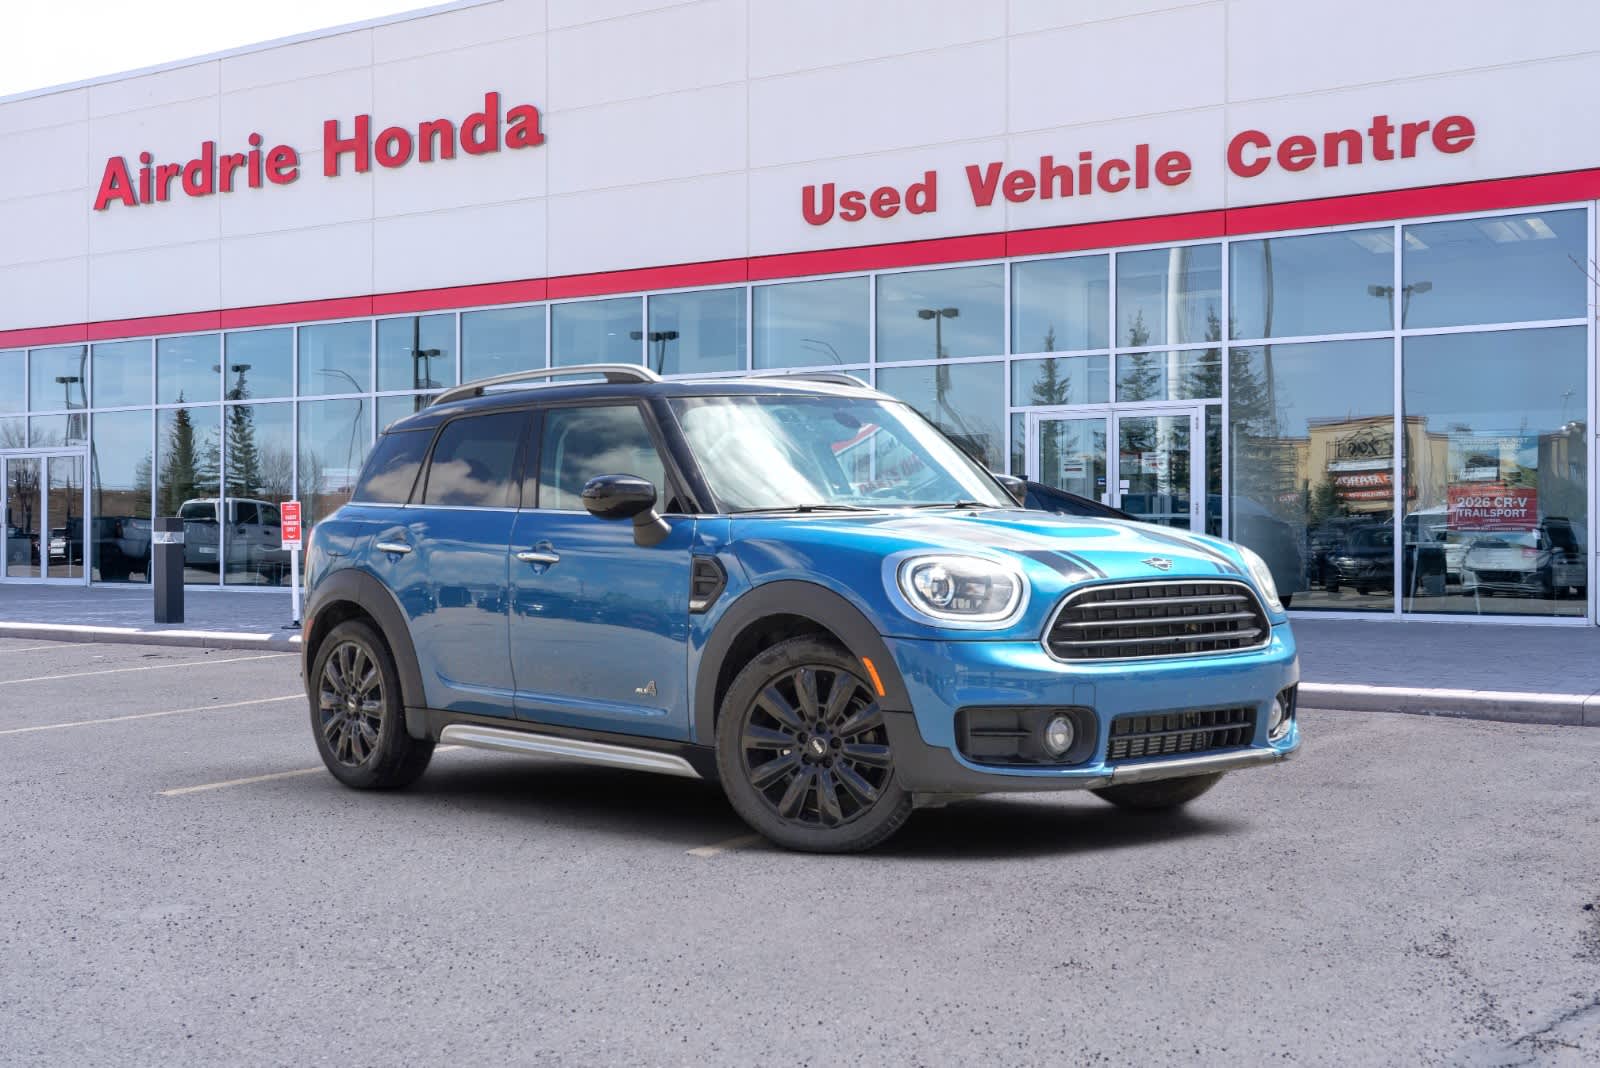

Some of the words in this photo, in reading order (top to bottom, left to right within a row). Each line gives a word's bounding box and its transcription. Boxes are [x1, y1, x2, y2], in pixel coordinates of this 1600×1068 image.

[94, 132, 299, 211] Airdrie
[323, 91, 546, 177] Honda
[802, 170, 937, 225] Used
[966, 143, 1192, 207] Vehicle
[1227, 115, 1476, 178] Centre
[1456, 497, 1490, 508] 2026
[1494, 497, 1528, 508] CR-V
[1457, 508, 1528, 518] TRAILSPORT
